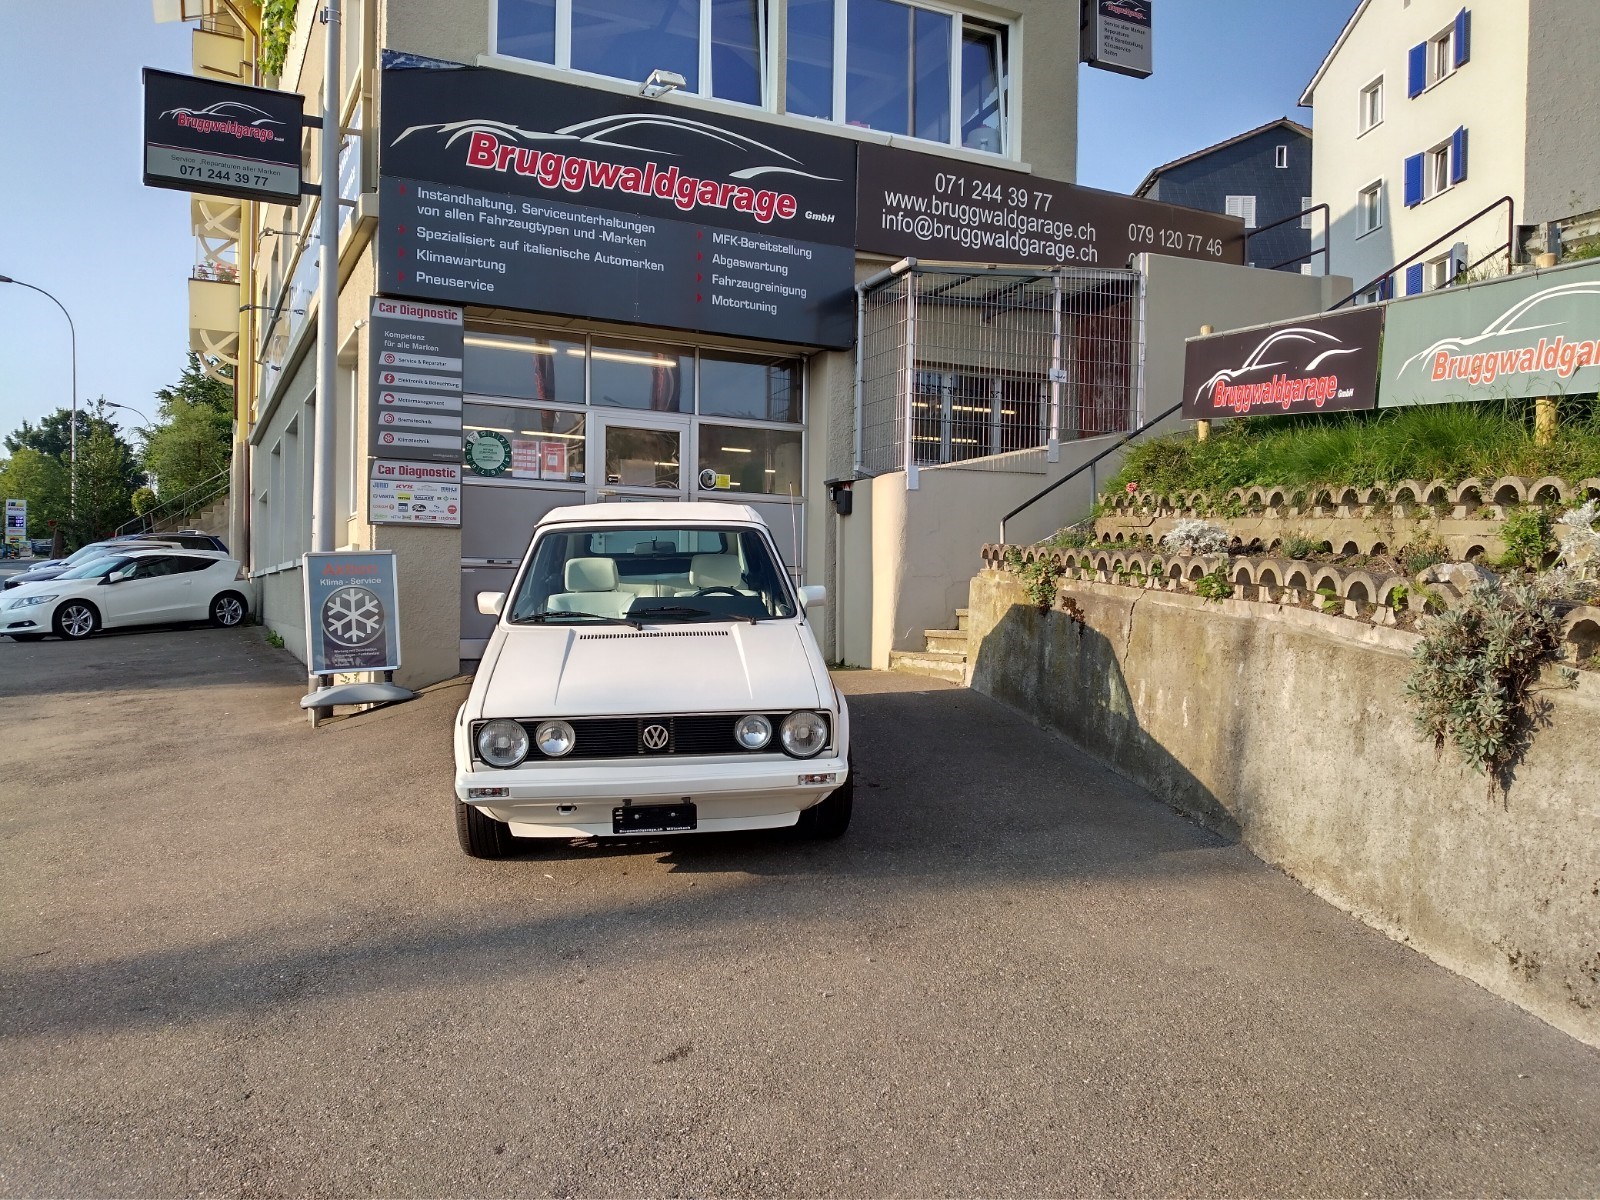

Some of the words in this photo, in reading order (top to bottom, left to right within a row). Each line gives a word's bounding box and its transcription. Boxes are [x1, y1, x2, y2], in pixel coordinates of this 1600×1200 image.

[178, 112, 274, 142] Bruggwaldgarage
[170, 154, 196, 164] Service
[258, 167, 281, 176] Marken
[180, 164, 202, 177] 071
[208, 169, 230, 182] 244
[234, 172, 250, 184] 39
[254, 176, 268, 187] 77
[466, 130, 797, 224] Bruggwaldgarage
[804, 210, 836, 224] GmbH
[934, 172, 965, 196] 071
[972, 180, 1002, 203] 244
[1008, 186, 1028, 208] 39
[1033, 192, 1053, 212] 77
[417, 187, 517, 214] Instandhaltung,
[522, 202, 656, 234] Serviceunterhaltungen
[884, 190, 1096, 242] www.bruggwaldgarage.ch
[417, 205, 440, 217] von
[444, 208, 474, 222] allen
[478, 212, 569, 236] Fahrzeugtypen
[573, 228, 596, 240] und
[598, 231, 647, 247] -Marken
[882, 210, 1098, 262] info@bruggwaldgarage.ch
[416, 226, 496, 248] Spezialisiert
[499, 240, 520, 250] auf
[523, 241, 590, 262] italienische
[594, 252, 664, 272] Automarken
[712, 232, 812, 260] MFK-Bereitstellung
[1128, 224, 1154, 244] 079
[1160, 229, 1182, 249] 120
[1187, 234, 1202, 252] 77
[1206, 238, 1222, 256] 46
[416, 249, 506, 274] Klimawartung
[712, 253, 788, 276] Abgaswartung
[416, 272, 494, 292] Pneuservice
[712, 274, 807, 298] Fahrzeugreinigung
[378, 302, 397, 314] Car
[400, 304, 458, 320] Diagnostic
[712, 294, 777, 315] Motortuning
[384, 330, 425, 341] Kompetenz
[412, 342, 439, 352] Marken
[1214, 373, 1338, 412] Bruggwaldgarage
[1338, 387, 1354, 398] GmbH
[378, 464, 396, 475] Car
[398, 465, 456, 478] Diagnostic
[320, 578, 344, 586] Klima
[350, 577, 382, 585] Service
